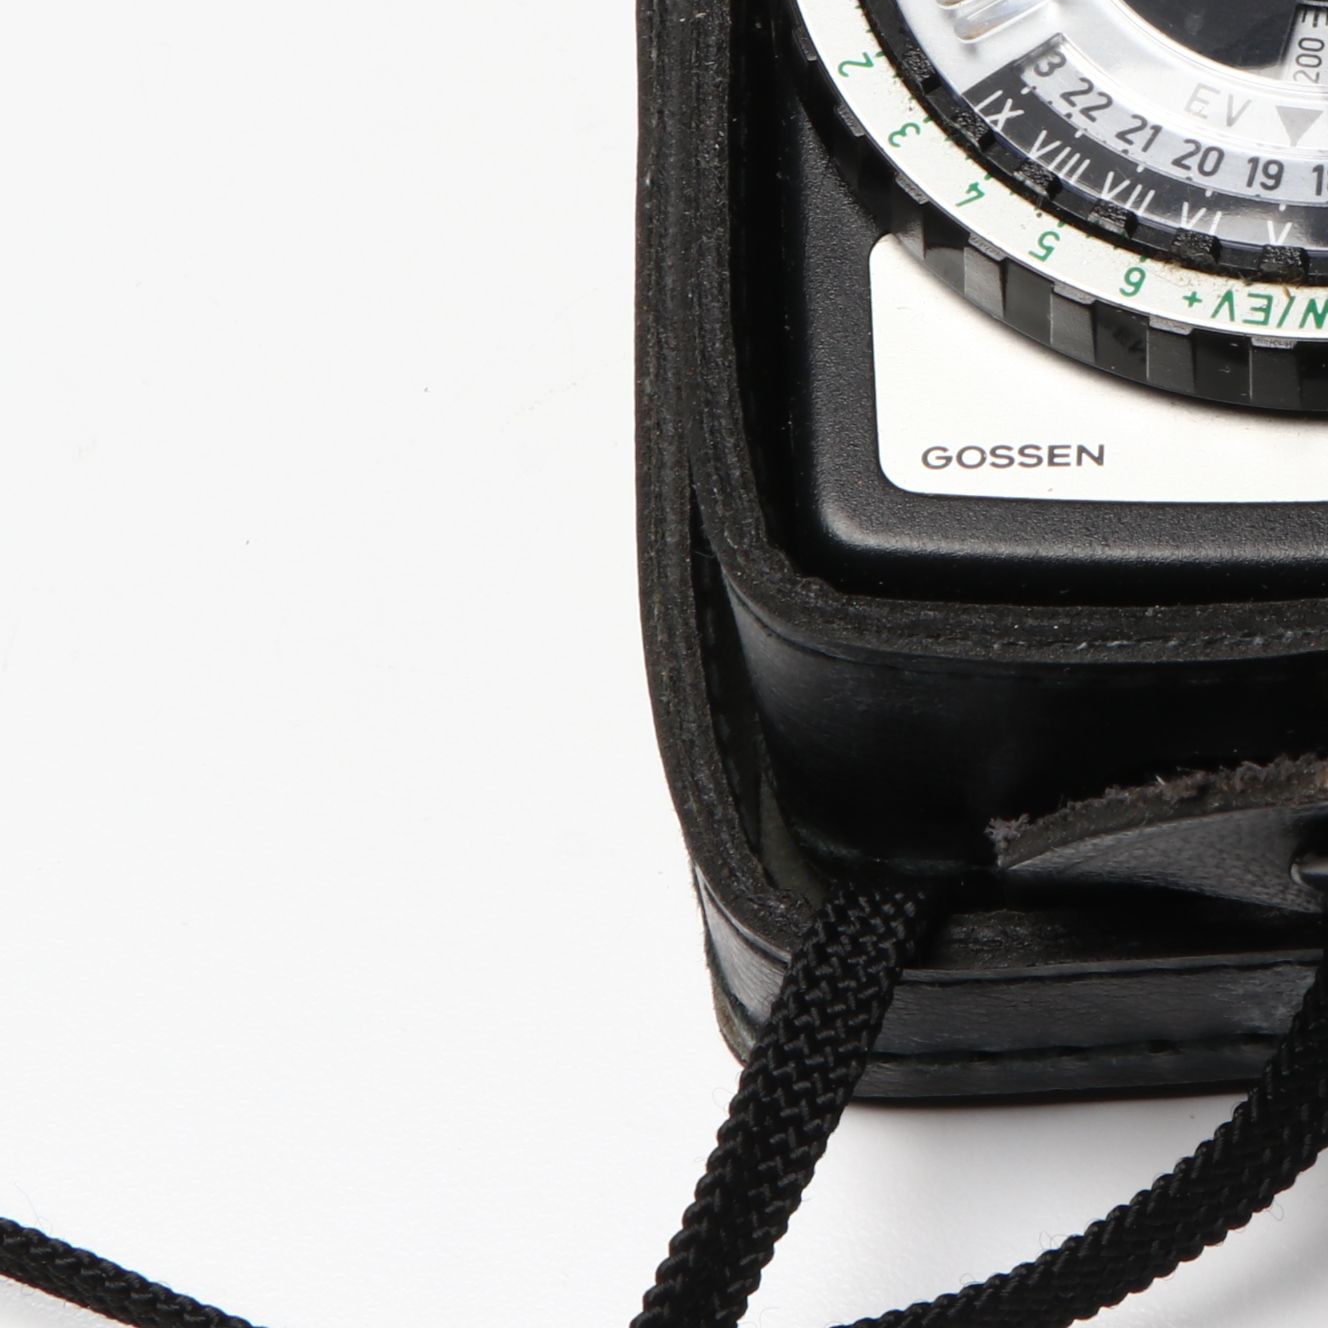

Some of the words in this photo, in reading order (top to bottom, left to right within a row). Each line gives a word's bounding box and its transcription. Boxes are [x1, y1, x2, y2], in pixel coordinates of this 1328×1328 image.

[837, 52, 874, 77] 2
[1293, 37, 1325, 84] 200
[1185, 82, 1252, 128] EV
[888, 122, 921, 147] 3
[1059, 77, 1113, 123] 22
[1115, 114, 1163, 153] 21
[1171, 139, 1225, 177] 20
[1245, 156, 1284, 191] 19
[956, 181, 985, 207] 4
[1028, 231, 1060, 262] 5
[921, 444, 1105, 470] GOSSEN
